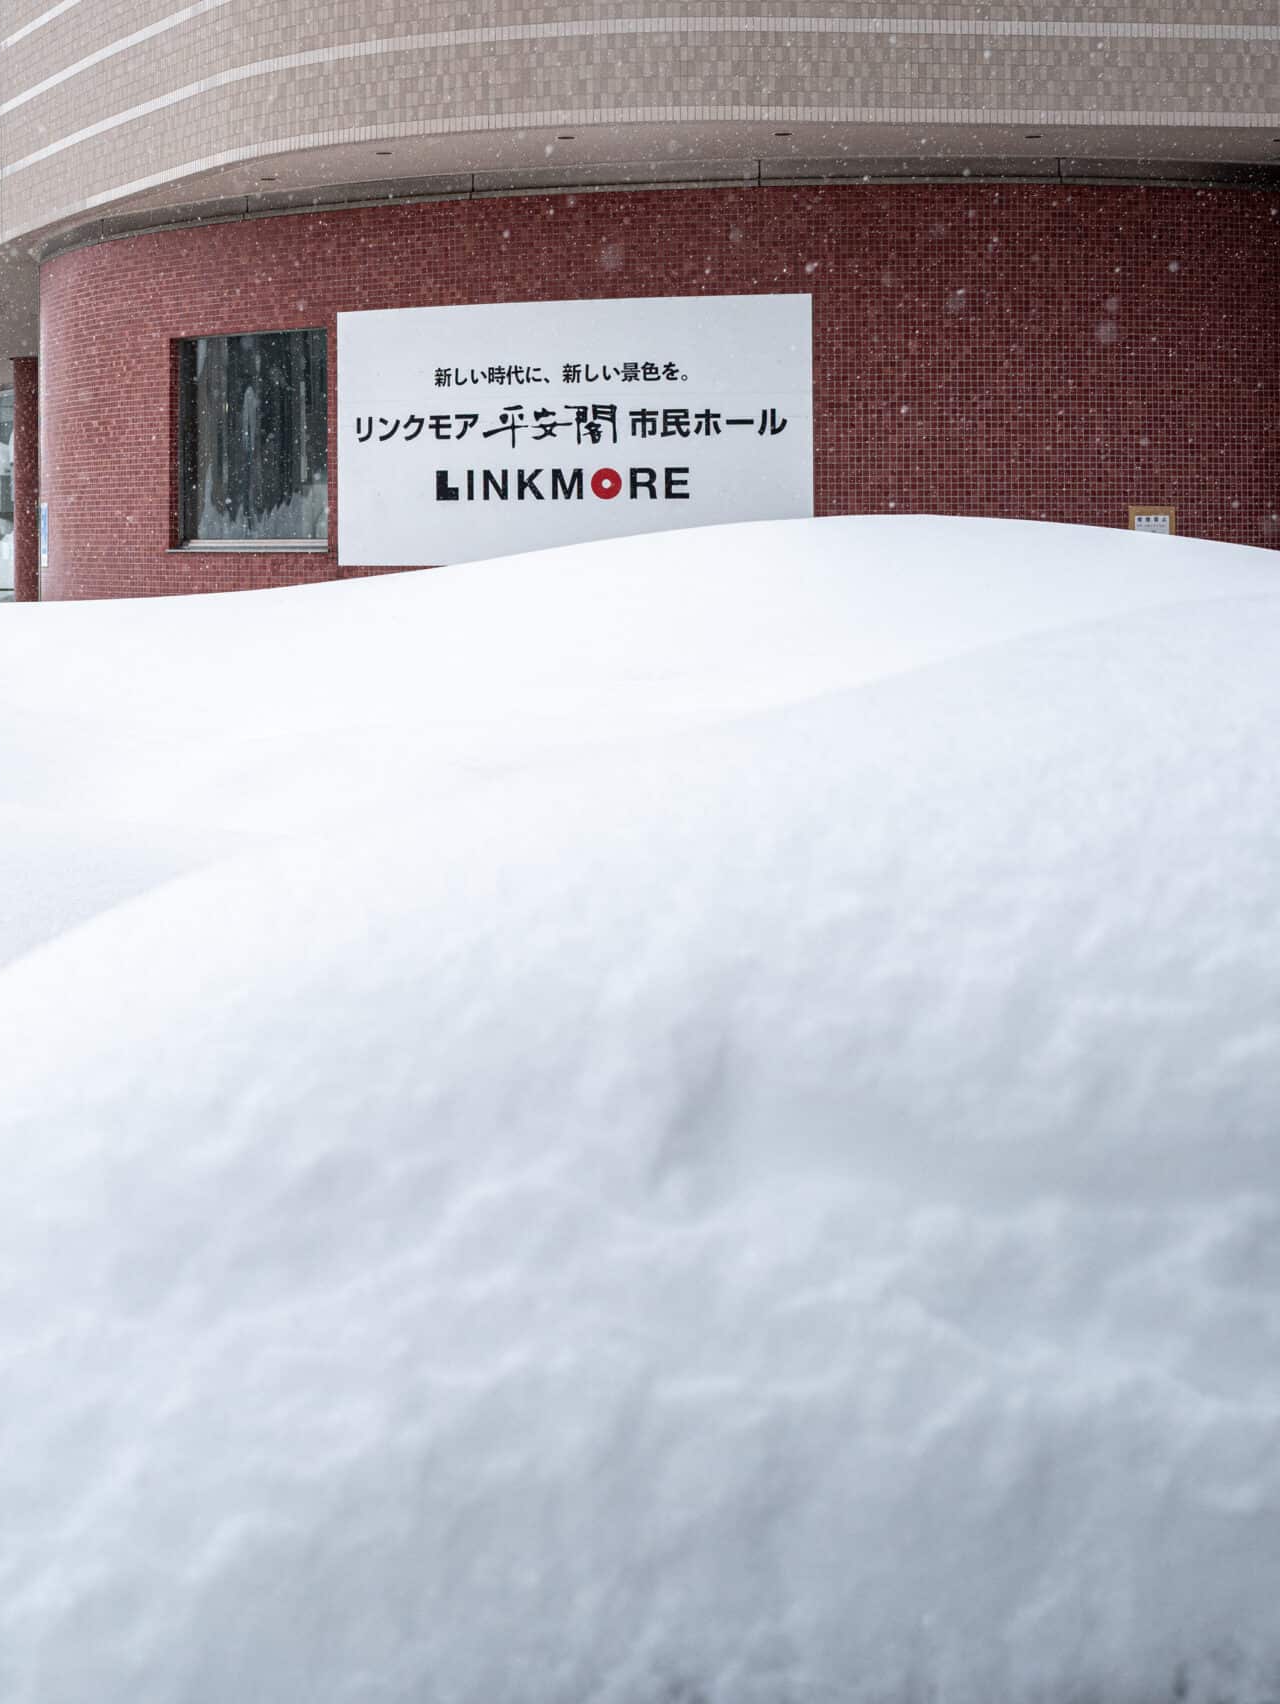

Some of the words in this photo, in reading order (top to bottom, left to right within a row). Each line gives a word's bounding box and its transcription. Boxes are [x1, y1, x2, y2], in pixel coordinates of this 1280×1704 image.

[433, 360, 690, 389] 新しい時代に、新しい景色を。
[435, 466, 691, 502] LINKMORE
